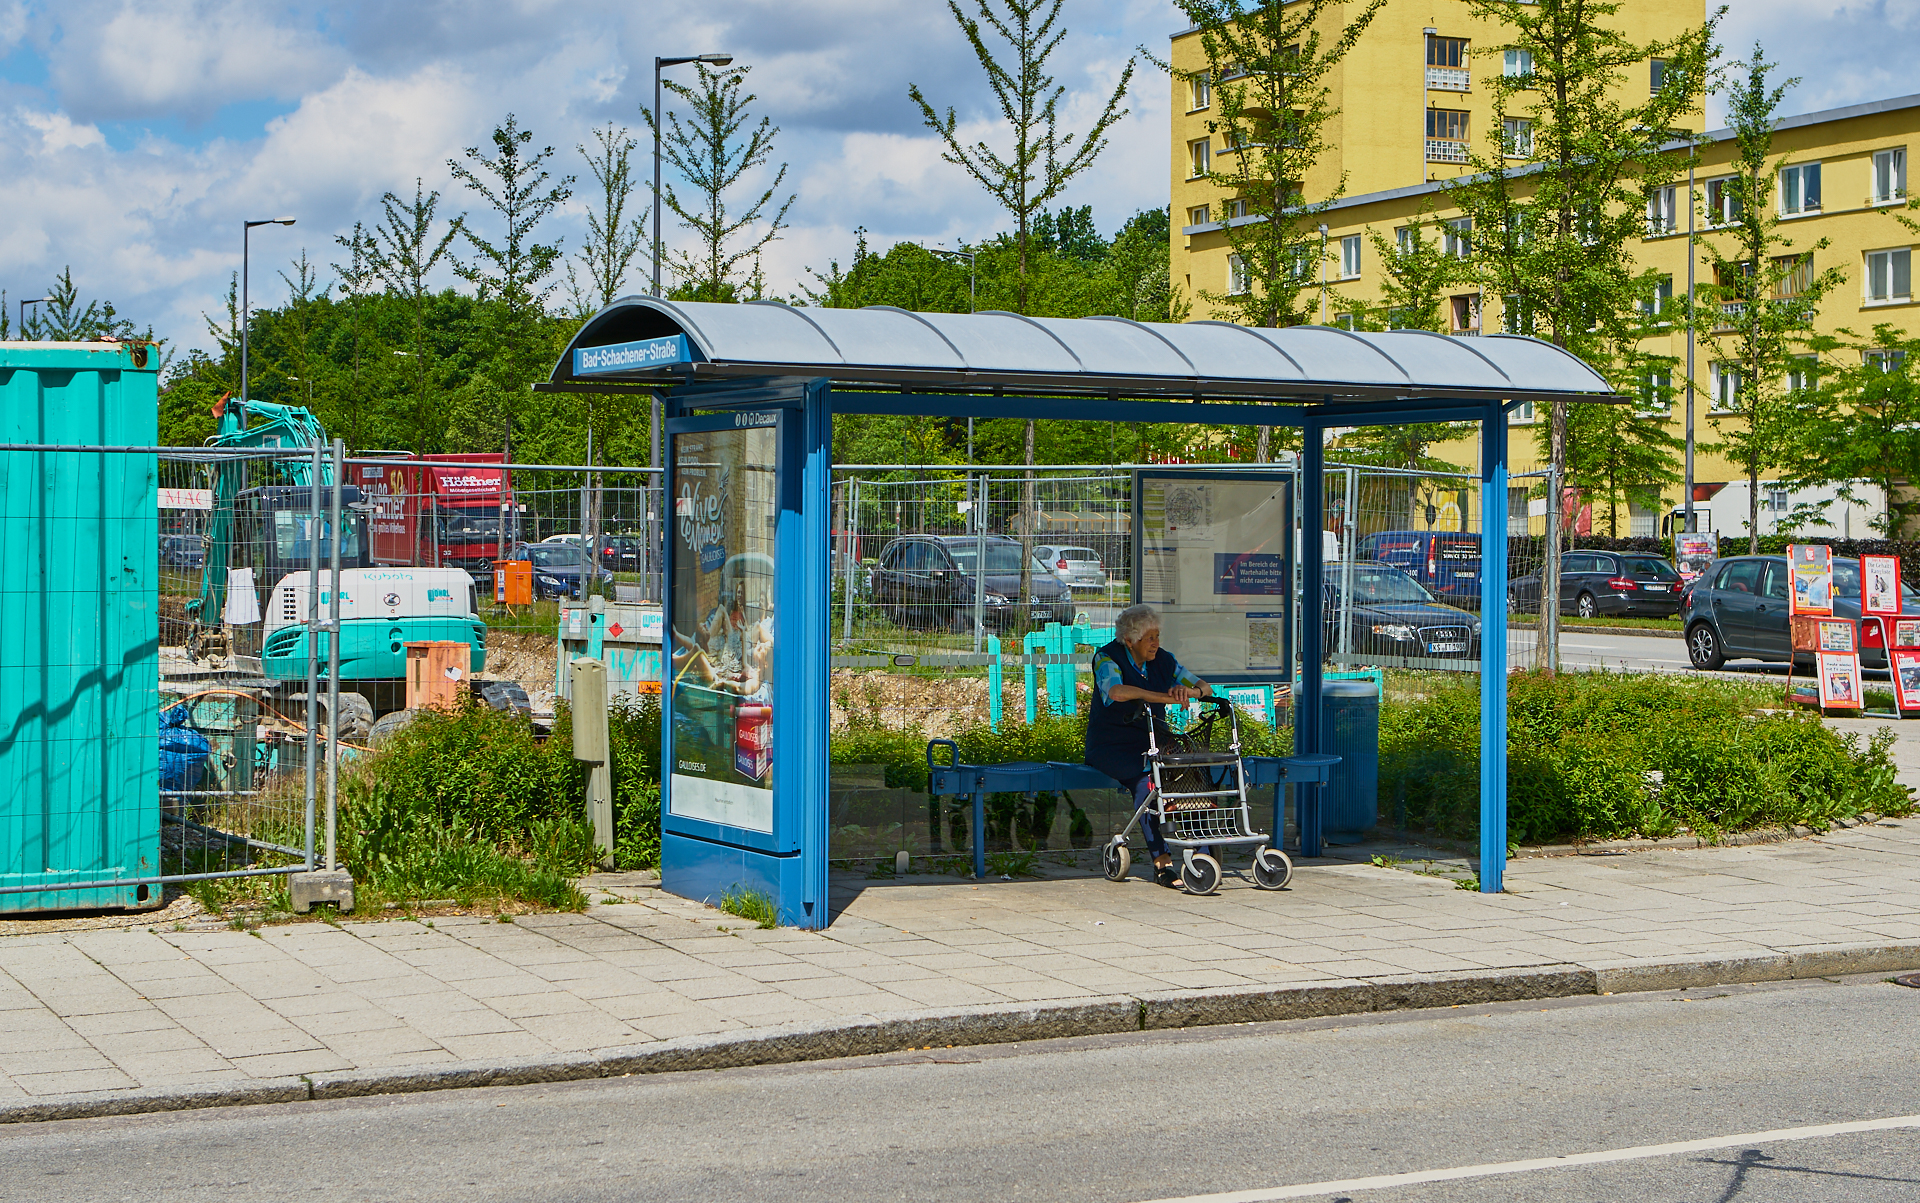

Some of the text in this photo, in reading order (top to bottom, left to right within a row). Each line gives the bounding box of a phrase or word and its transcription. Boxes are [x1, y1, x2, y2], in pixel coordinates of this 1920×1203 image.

[582, 340, 677, 368] Bad-Schachener-Straße
[440, 476, 501, 487] Höffner
[681, 482, 728, 524] Vive
[678, 759, 707, 773] GAULOISES.DE
